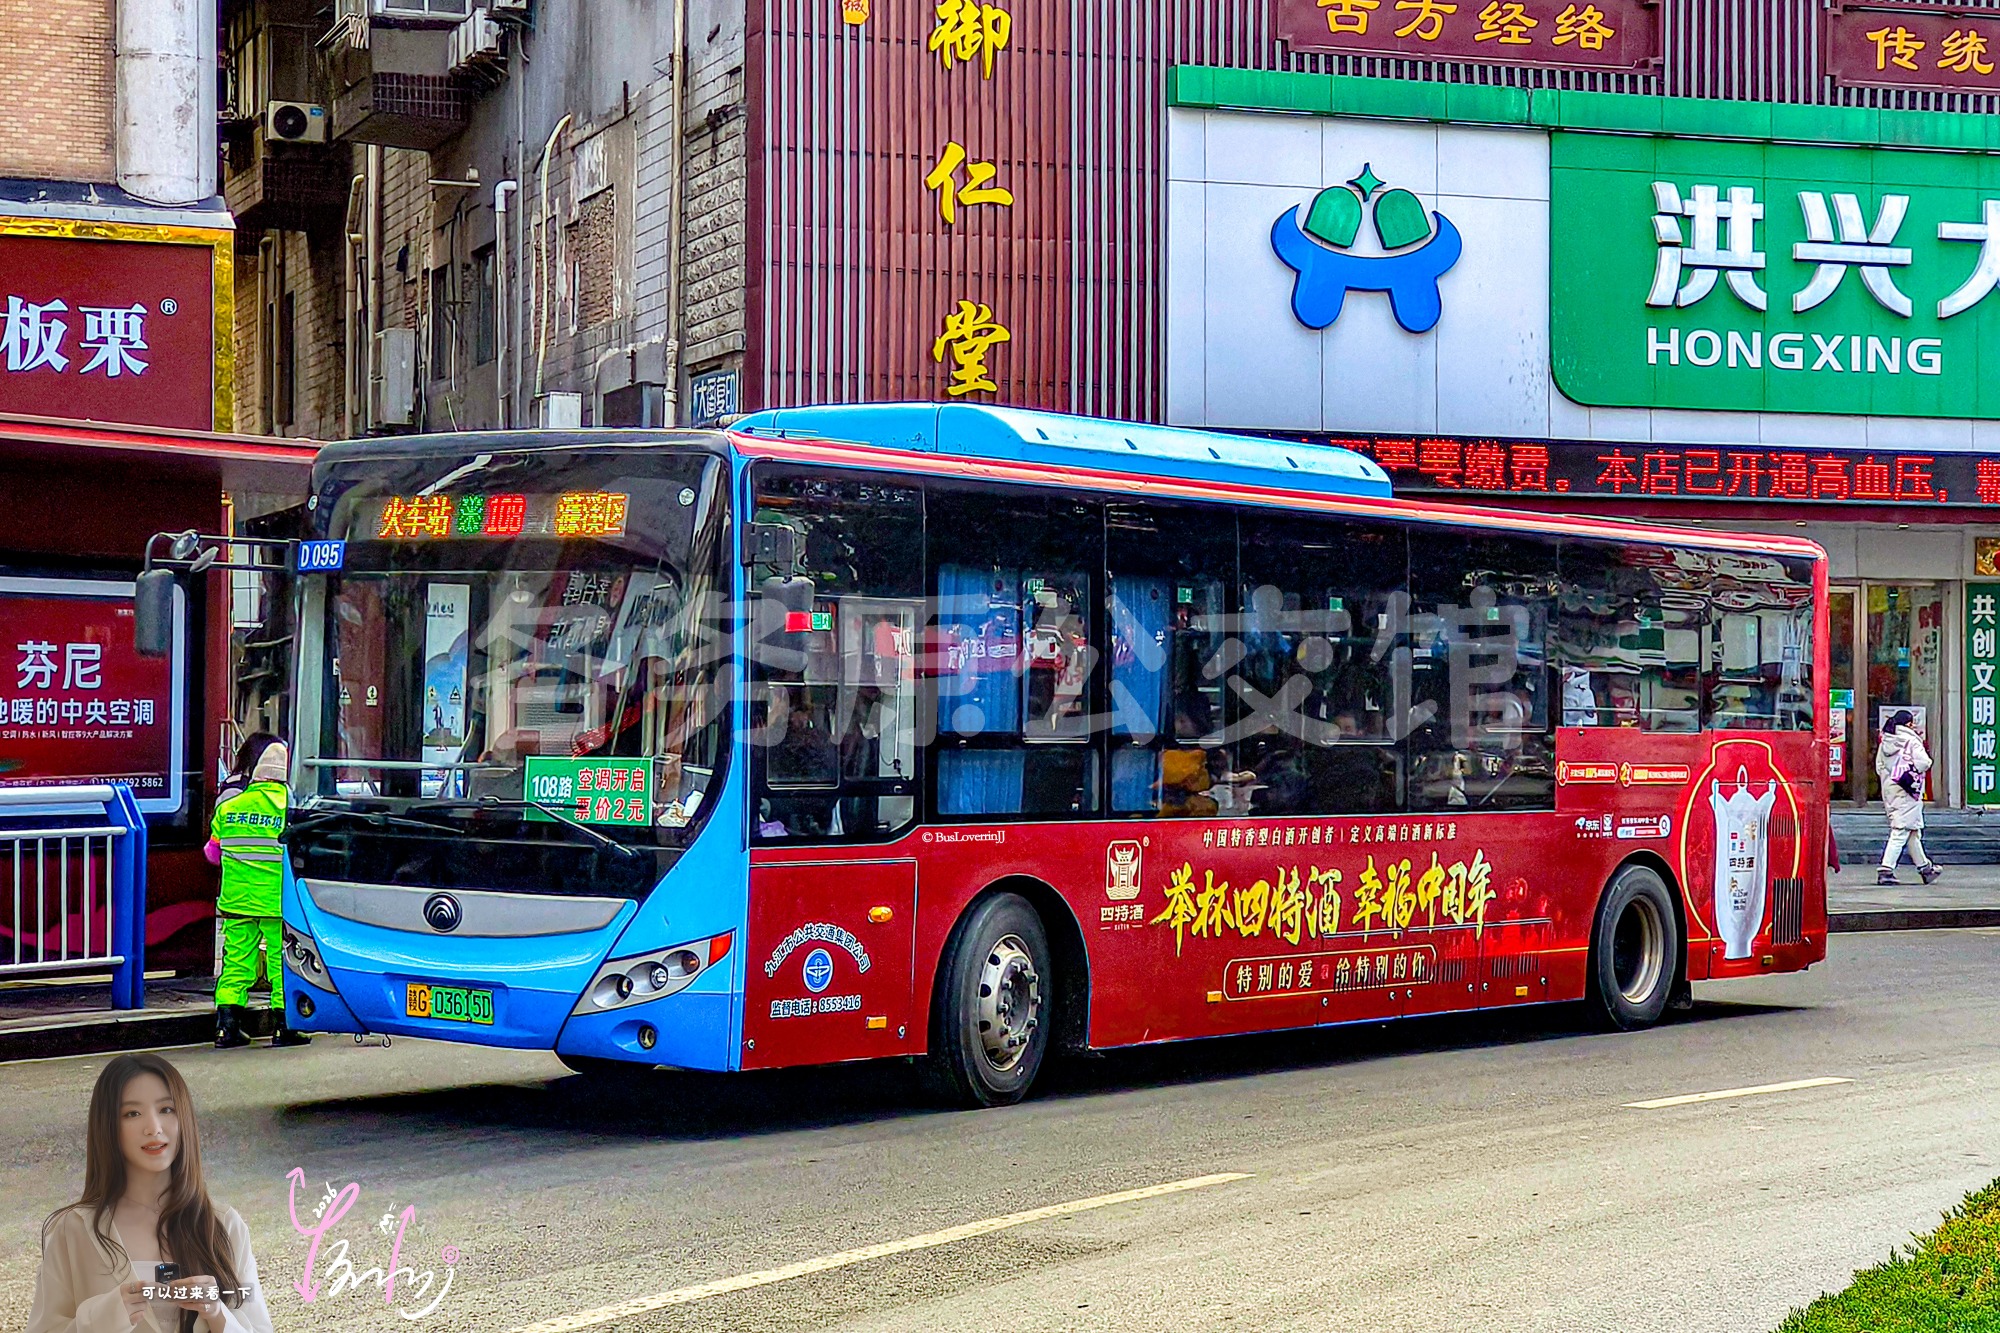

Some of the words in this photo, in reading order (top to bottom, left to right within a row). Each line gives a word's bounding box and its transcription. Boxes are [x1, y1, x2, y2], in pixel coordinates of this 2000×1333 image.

[1865, 26, 1996, 76] 传统
[925, 0, 1014, 397] 御仁堂
[0, 296, 149, 378] 板栗
[1647, 326, 1943, 376] HONGXING
[379, 496, 453, 537] 火车站
[487, 494, 526, 534] 108
[300, 544, 310, 568] D
[312, 543, 340, 567] 095
[17, 641, 102, 690] 芬尼
[1972, 594, 1996, 795] 共创文明城市
[142, 777, 163, 788] 5862
[532, 775, 573, 798] 108路
[578, 768, 645, 792] 空调开启
[574, 797, 645, 822] 票价2元
[1100, 904, 1144, 922] 四特酒
[764, 922, 872, 977] 九江市公共交通集团公司
[1236, 960, 1313, 993] 特别的爱
[1336, 951, 1426, 984] 给特别的你
